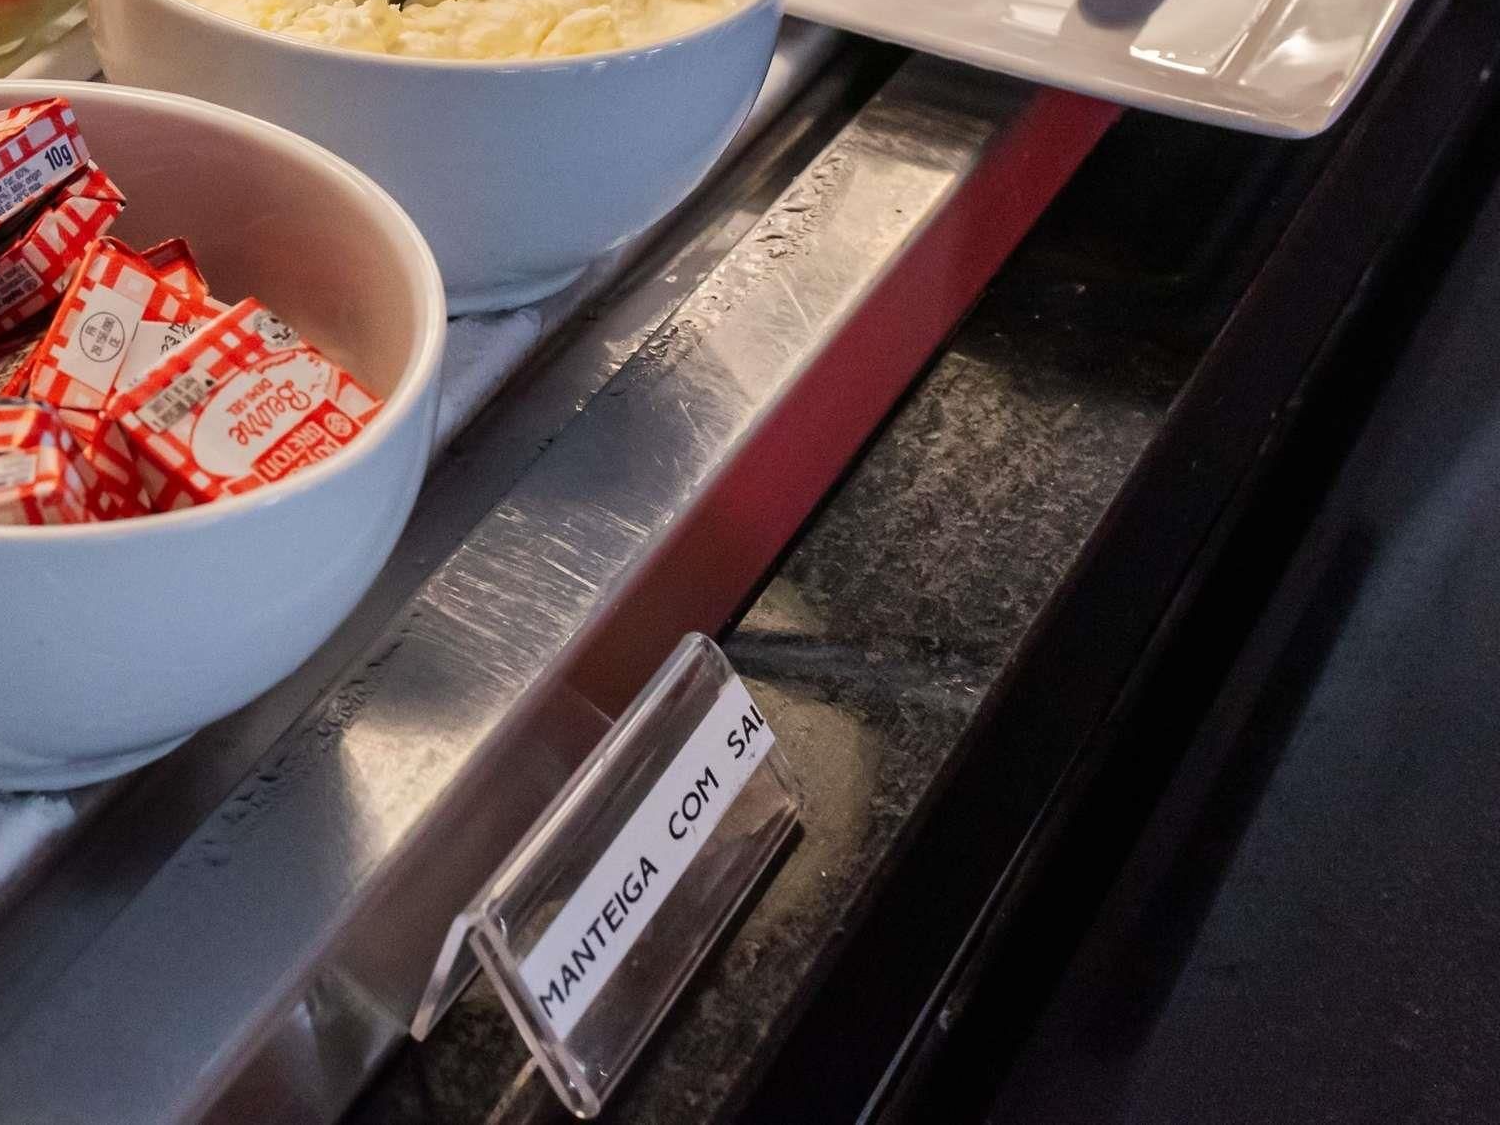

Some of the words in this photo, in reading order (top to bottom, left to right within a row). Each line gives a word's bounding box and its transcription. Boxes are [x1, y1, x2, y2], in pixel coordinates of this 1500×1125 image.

[44, 143, 73, 171] 10g
[228, 379, 312, 446] Beurre
[259, 421, 322, 478] BRETON
[539, 856, 659, 1019] MANTEIGA
[667, 766, 720, 841] COM
